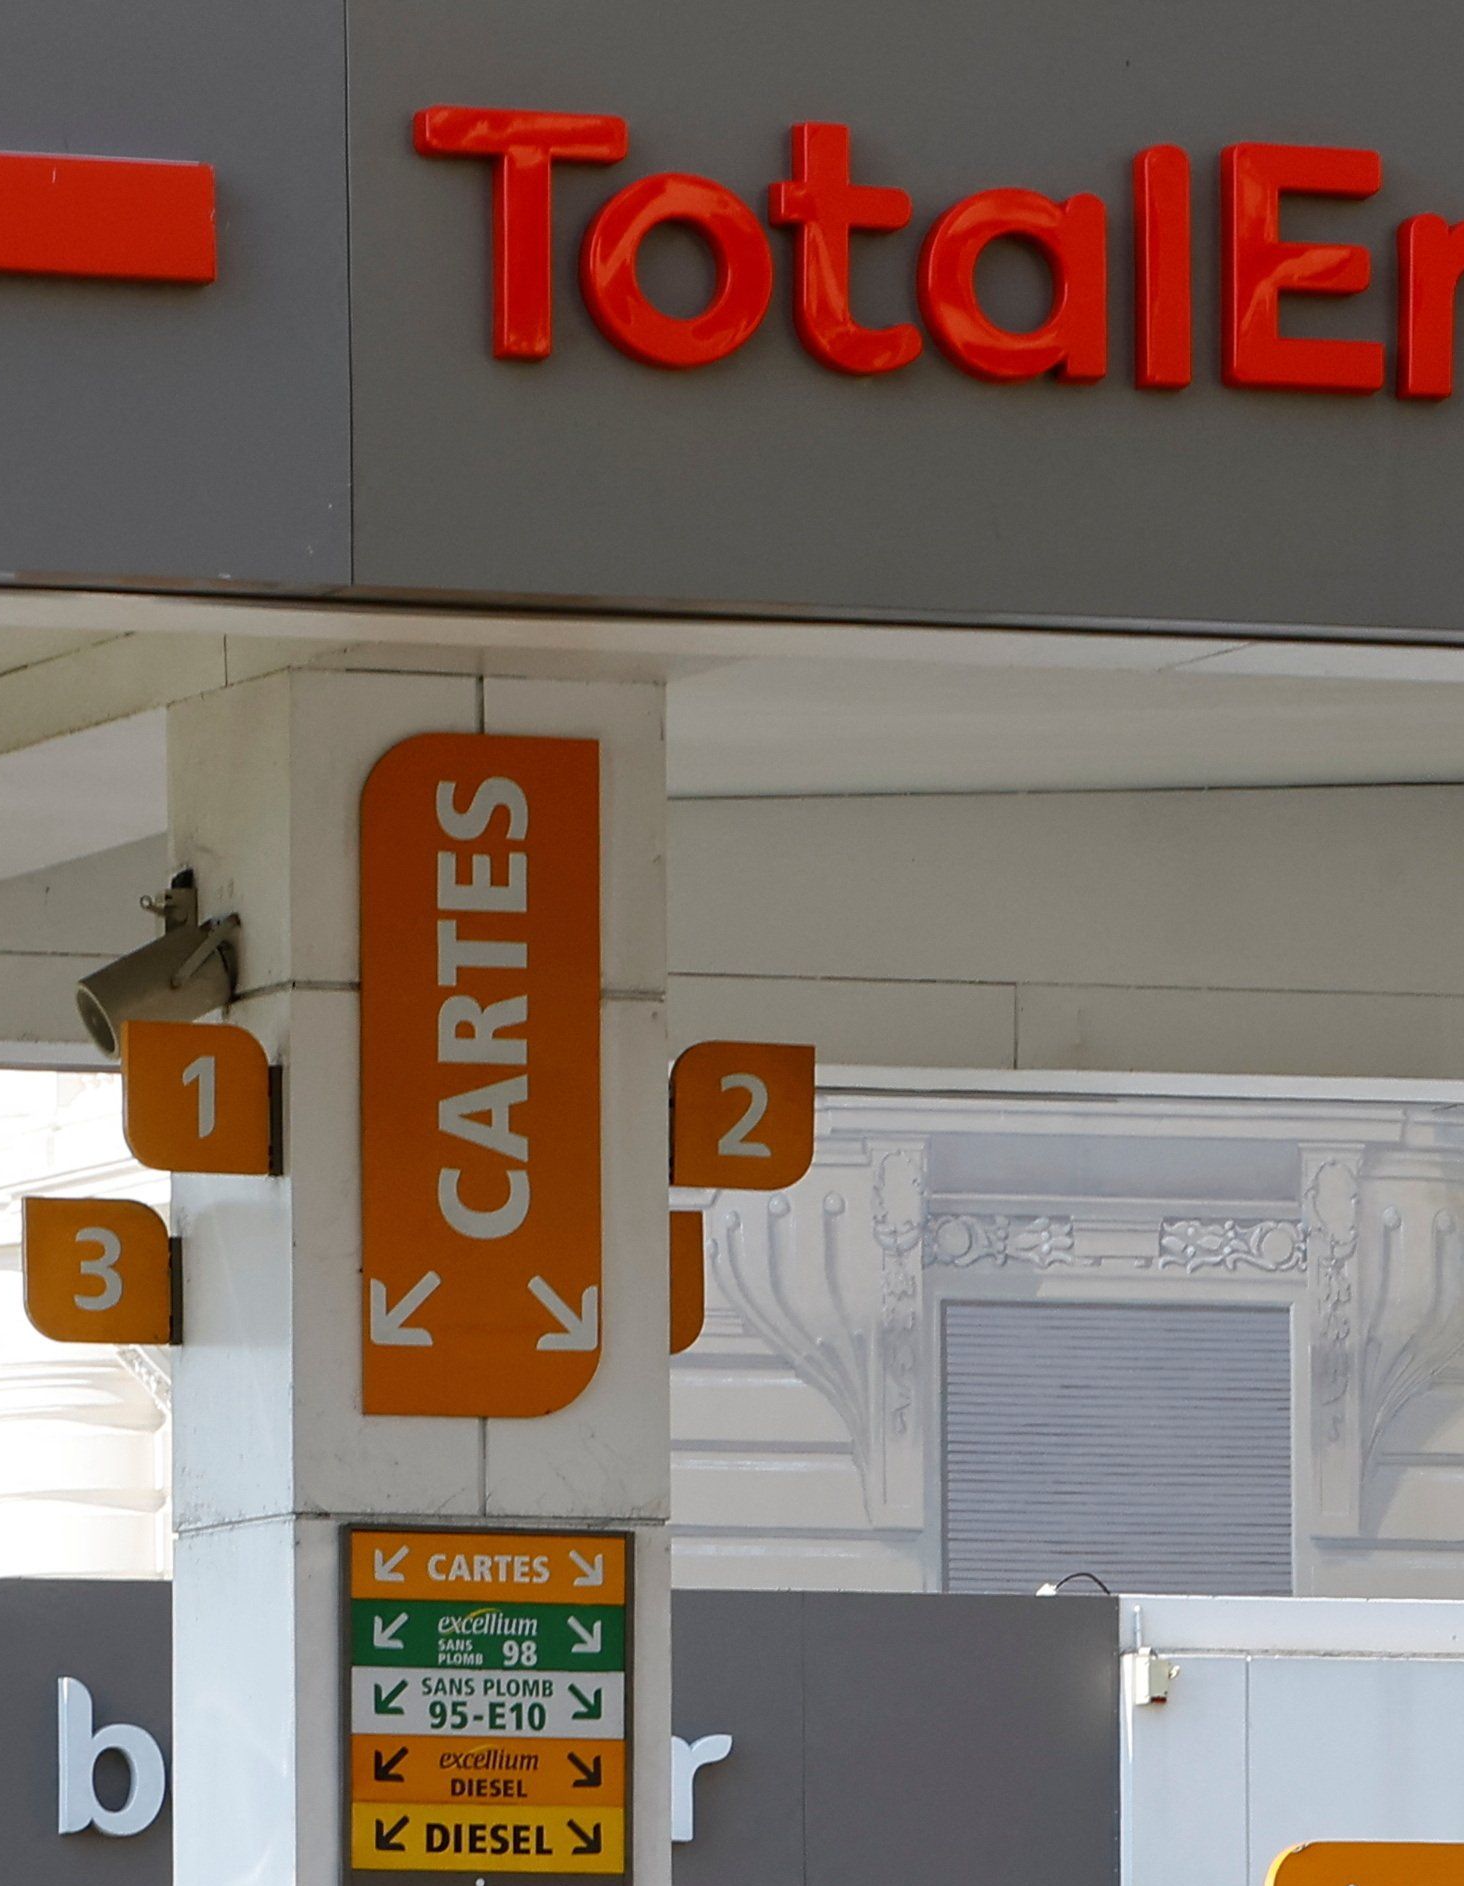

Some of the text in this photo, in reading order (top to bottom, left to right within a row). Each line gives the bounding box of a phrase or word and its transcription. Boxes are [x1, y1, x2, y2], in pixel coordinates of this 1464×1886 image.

[435, 775, 531, 1240] CARTES
[181, 1055, 217, 1139] 1
[717, 1073, 772, 1159] 2
[73, 1227, 123, 1311] 3
[427, 1554, 550, 1584] CARTES
[438, 1610, 538, 1637] excellium
[438, 1638, 473, 1652] SANS
[438, 1640, 538, 1667] PLOMB 98
[422, 1676, 554, 1698] SANS PLOMB
[429, 1700, 547, 1731] 95-E10
[439, 1747, 539, 1771] excellium
[451, 1778, 527, 1798] DIESEL
[425, 1823, 553, 1855] DIESEL
